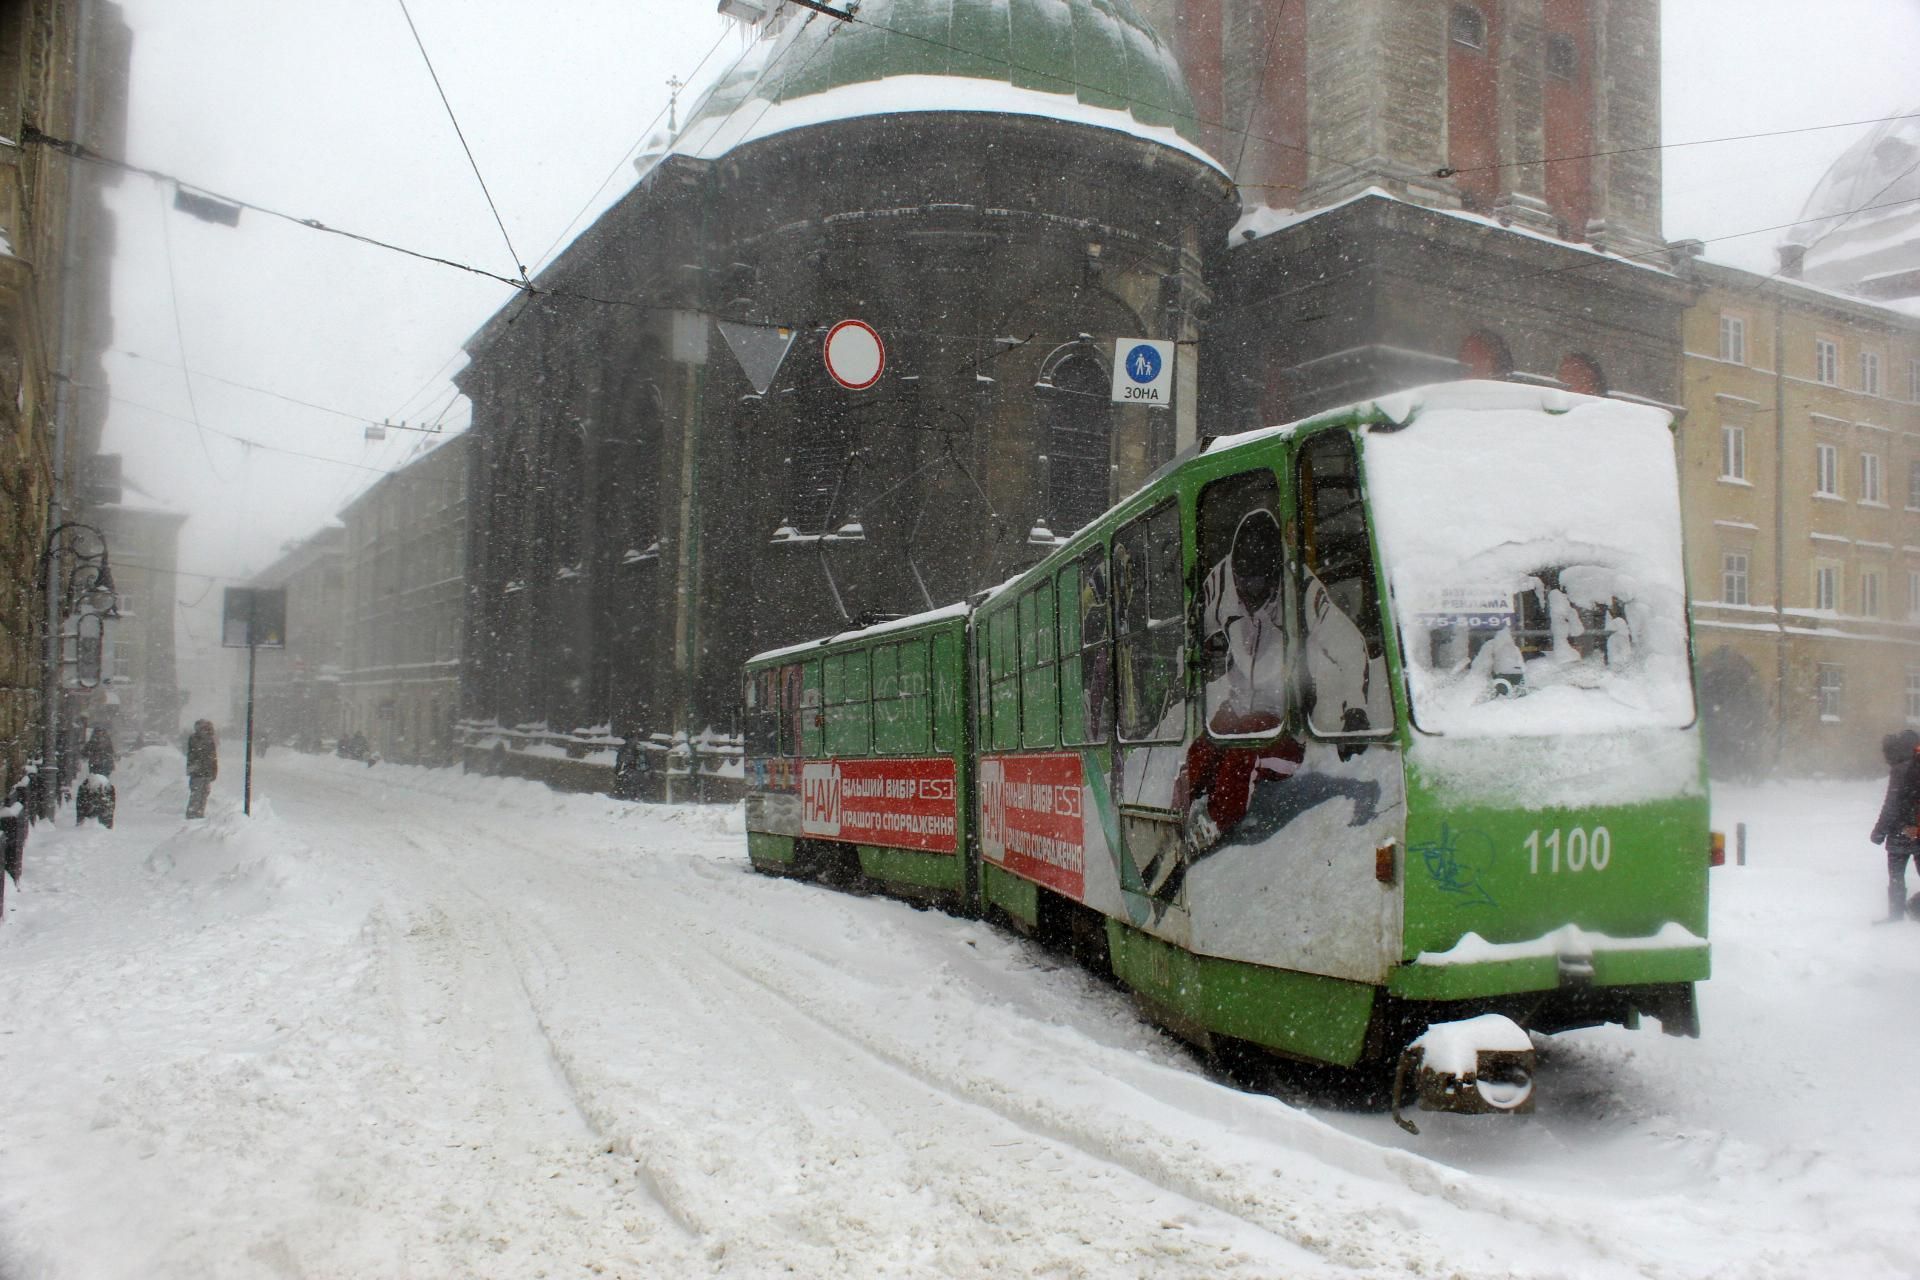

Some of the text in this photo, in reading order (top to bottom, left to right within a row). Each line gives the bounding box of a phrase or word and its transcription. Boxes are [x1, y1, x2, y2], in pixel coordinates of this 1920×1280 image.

[1124, 386, 1159, 400] ЗОНА
[885, 778, 916, 799] ВИБІР
[883, 811, 955, 836] СПОРЯДЖЕННЯ
[1523, 825, 1611, 875] 1100
